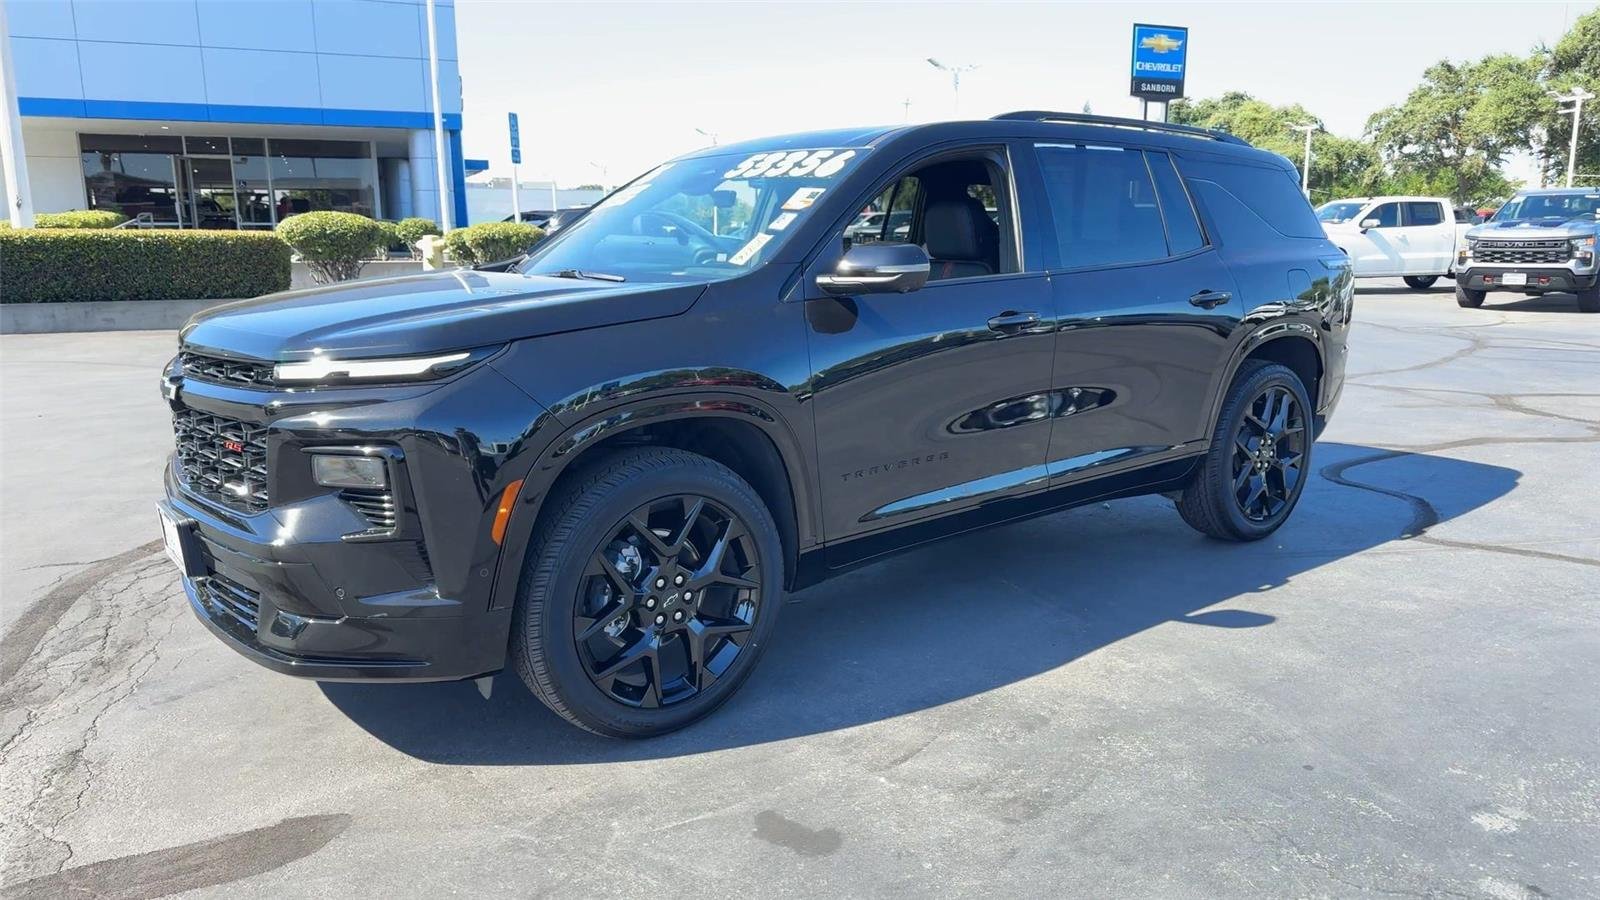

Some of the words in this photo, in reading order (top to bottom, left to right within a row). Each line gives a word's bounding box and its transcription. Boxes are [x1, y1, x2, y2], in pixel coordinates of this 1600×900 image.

[1136, 62, 1182, 72] CHEVROLET
[1141, 83, 1176, 93] SANBORN
[1479, 240, 1565, 249] CHEVROLET
[224, 441, 242, 452] RS
[841, 452, 949, 481] TRAVERSE
